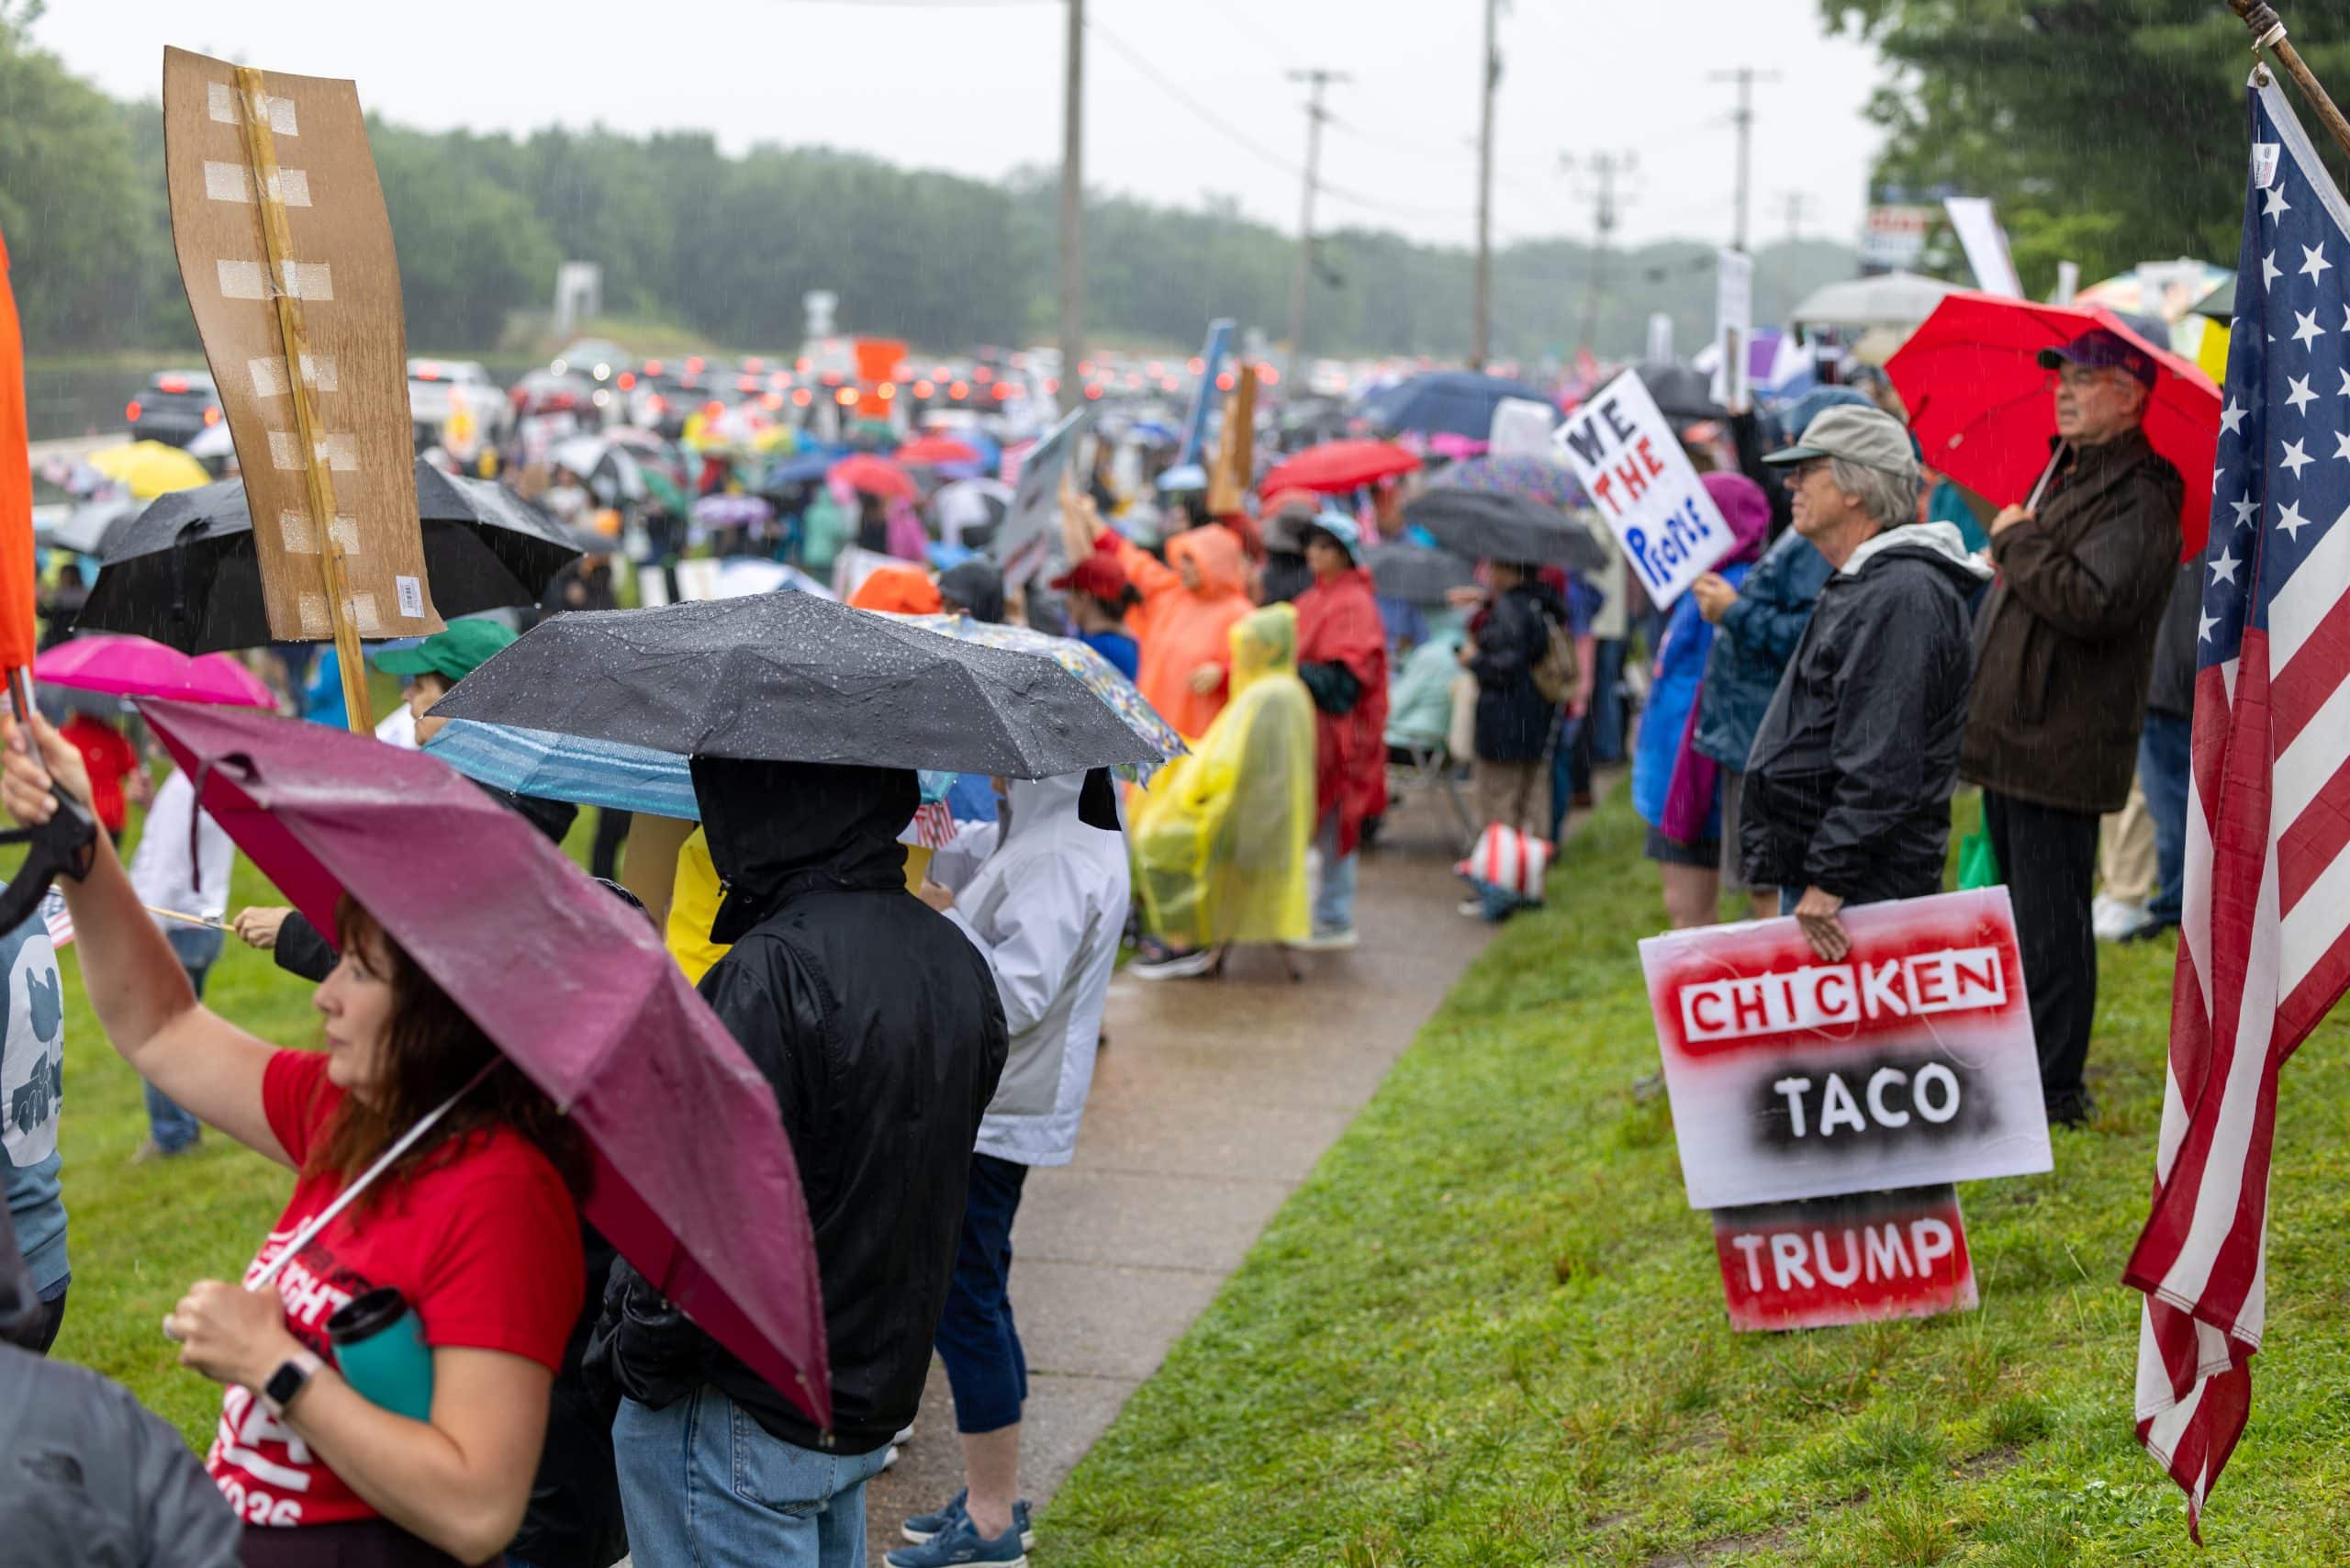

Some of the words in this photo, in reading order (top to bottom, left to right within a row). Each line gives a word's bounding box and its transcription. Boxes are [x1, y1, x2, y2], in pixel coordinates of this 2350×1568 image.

[1566, 398, 1638, 467] WE
[1594, 435, 1664, 515] THE
[1685, 951, 2005, 1036] CHICKEN
[1774, 1061, 1962, 1137] TACO
[1732, 1217, 1955, 1293] TRUMP
